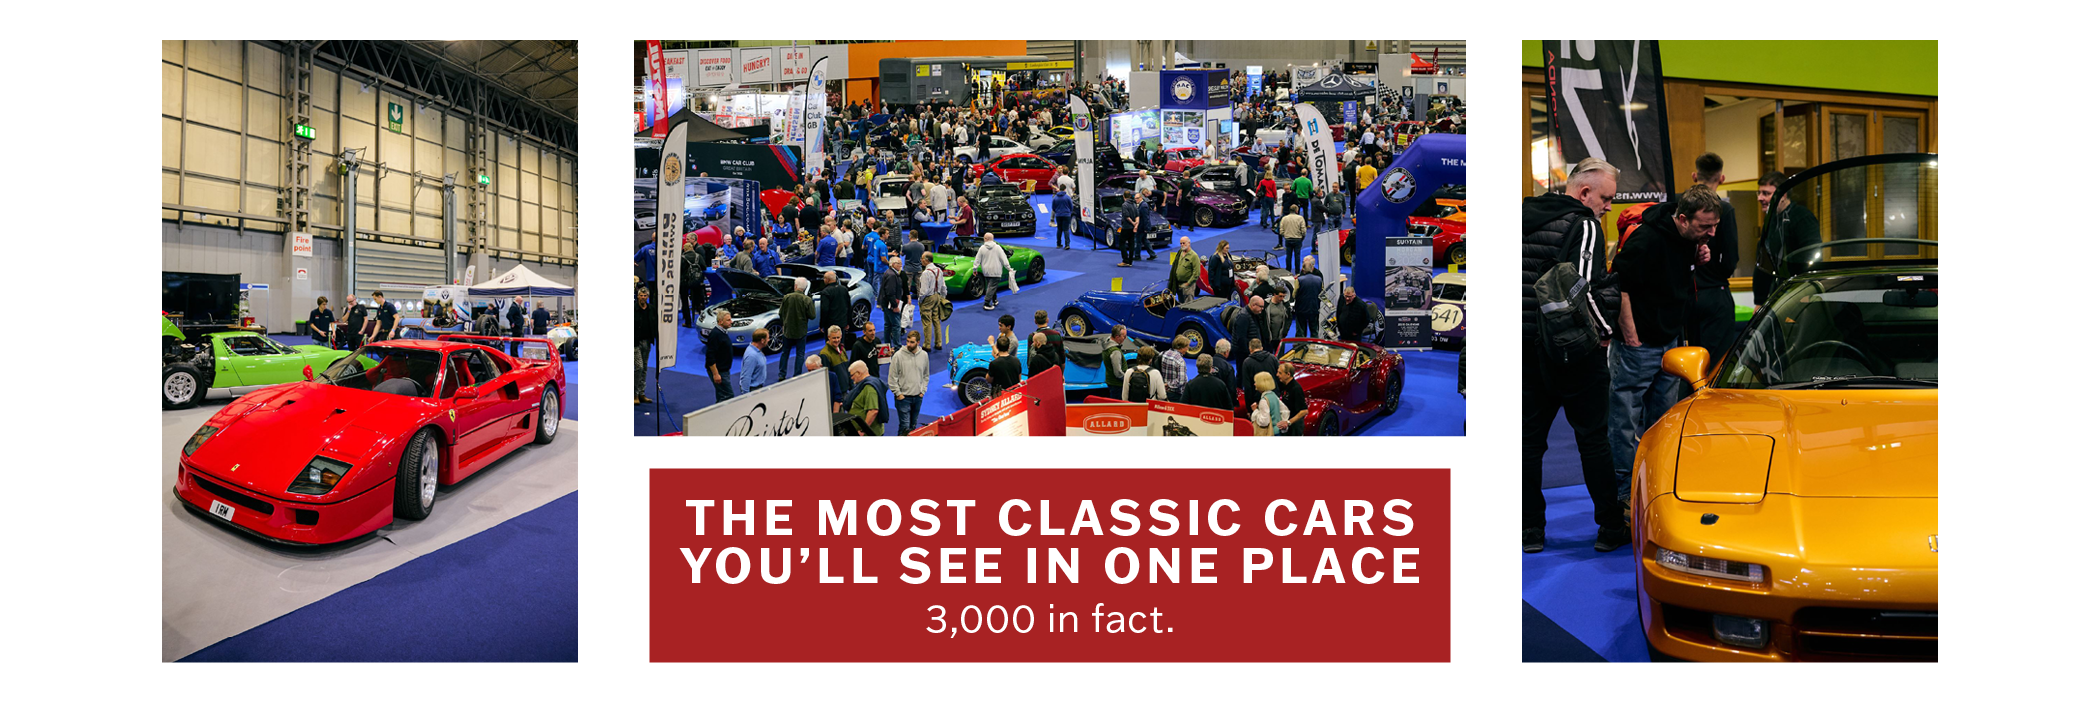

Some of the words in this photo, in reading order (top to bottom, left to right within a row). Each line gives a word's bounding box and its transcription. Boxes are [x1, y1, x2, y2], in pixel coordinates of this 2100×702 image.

[787, 52, 798, 60] DIE
[664, 57, 685, 66] EAKFAST
[743, 57, 770, 73] HUNGRY?
[808, 112, 822, 120] Club
[391, 121, 401, 132] EXIT
[807, 121, 818, 129] GB
[1311, 139, 1321, 154] DE
[1441, 157, 1459, 166] THE
[295, 235, 310, 244] Fire
[293, 244, 311, 253] point
[463, 321, 473, 332] 91
[725, 398, 810, 437] Bistol
[1089, 420, 1125, 428] ALLARD
